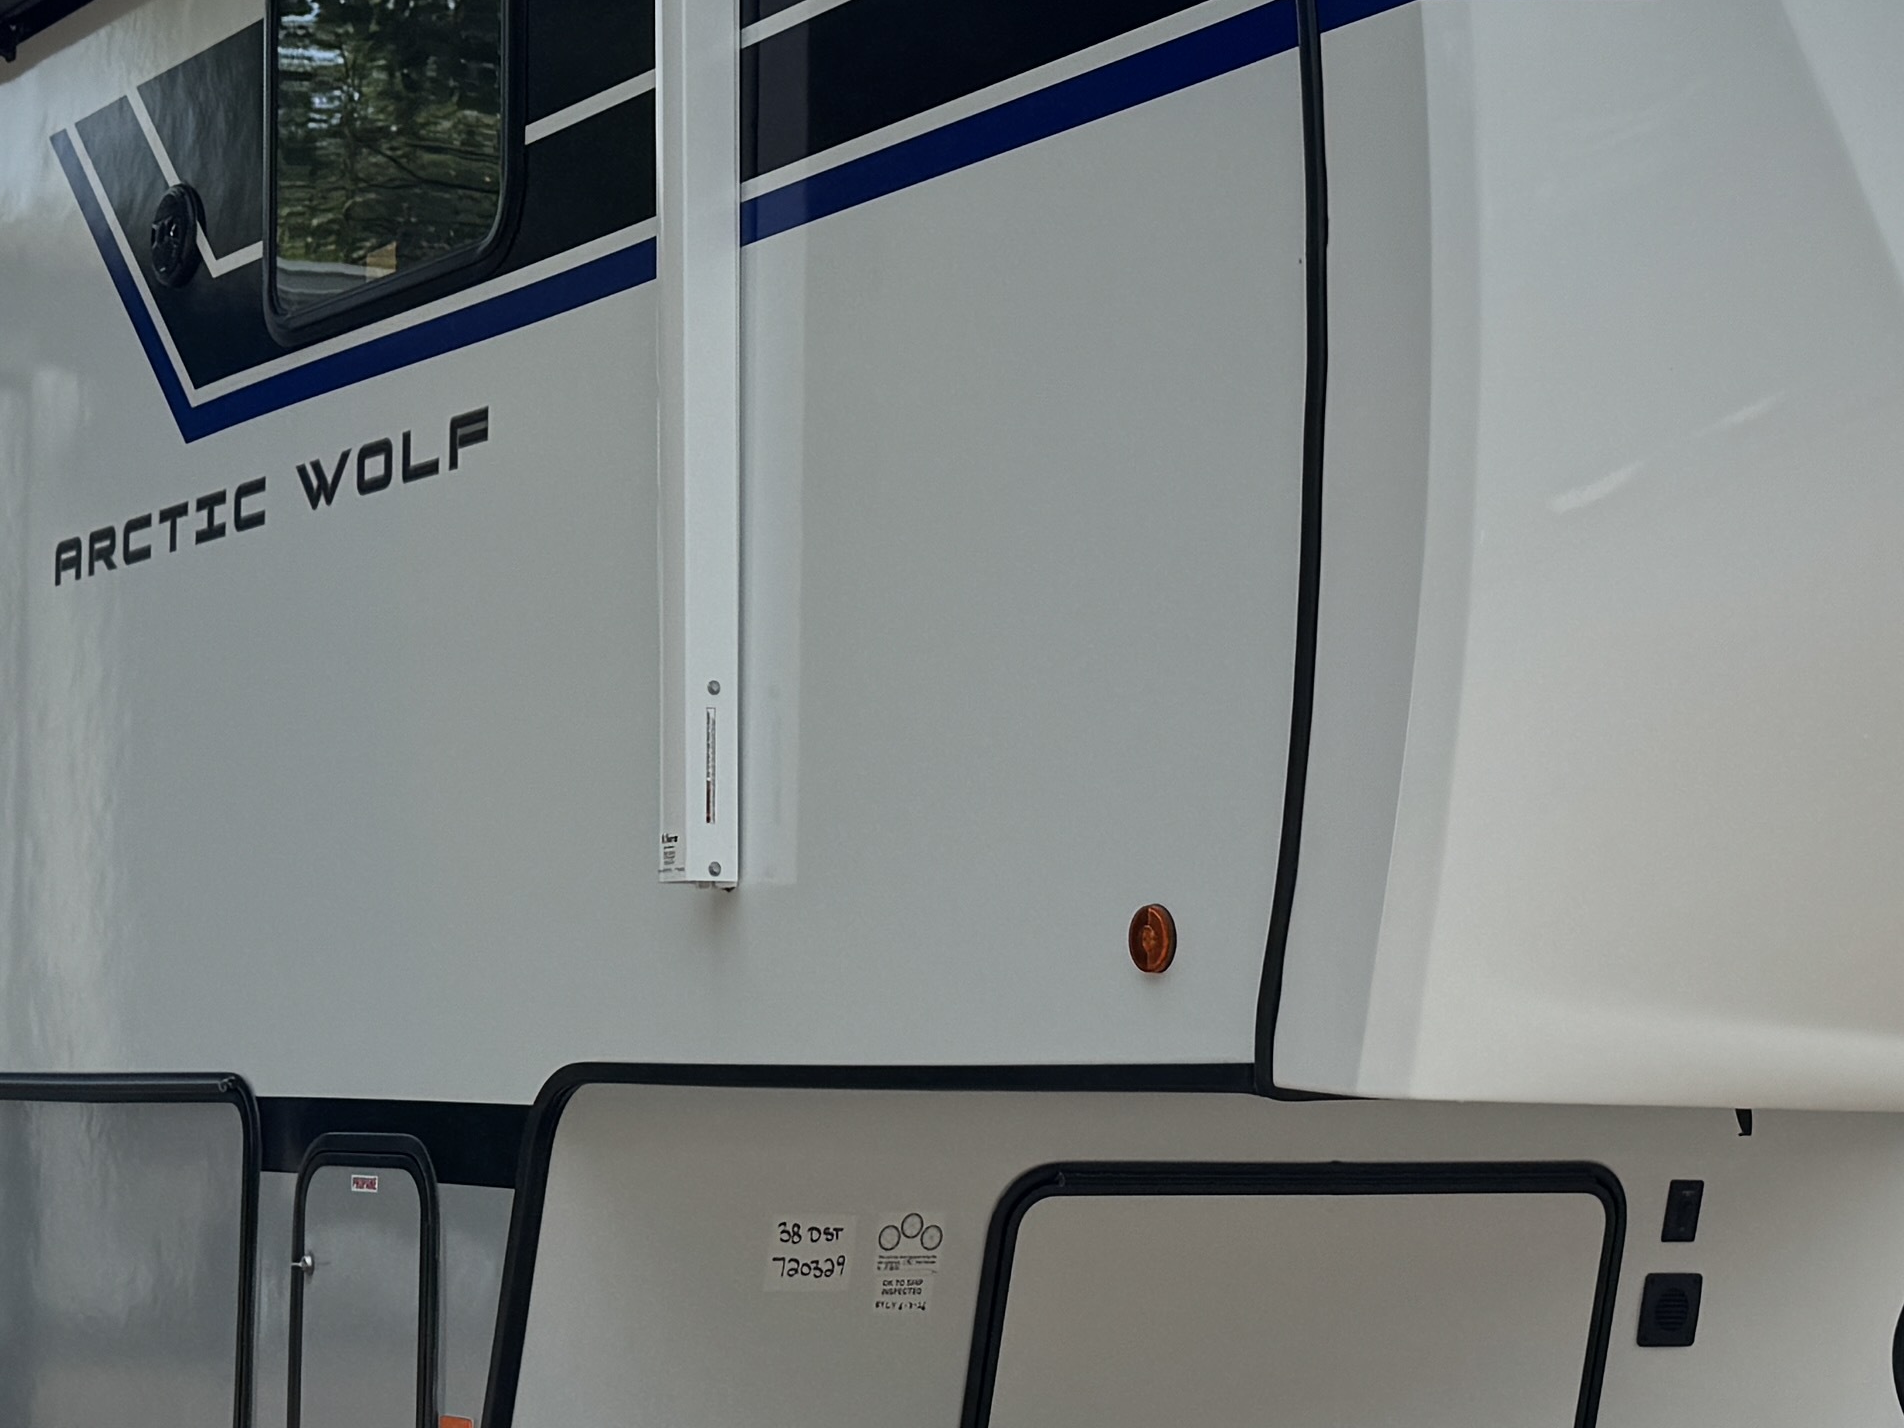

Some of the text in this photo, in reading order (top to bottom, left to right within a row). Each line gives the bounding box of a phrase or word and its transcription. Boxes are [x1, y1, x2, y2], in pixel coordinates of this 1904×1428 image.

[54, 405, 490, 587] ARCTIC WOLF
[778, 1221, 845, 1245] 38 DST
[772, 1254, 847, 1279] 720329
